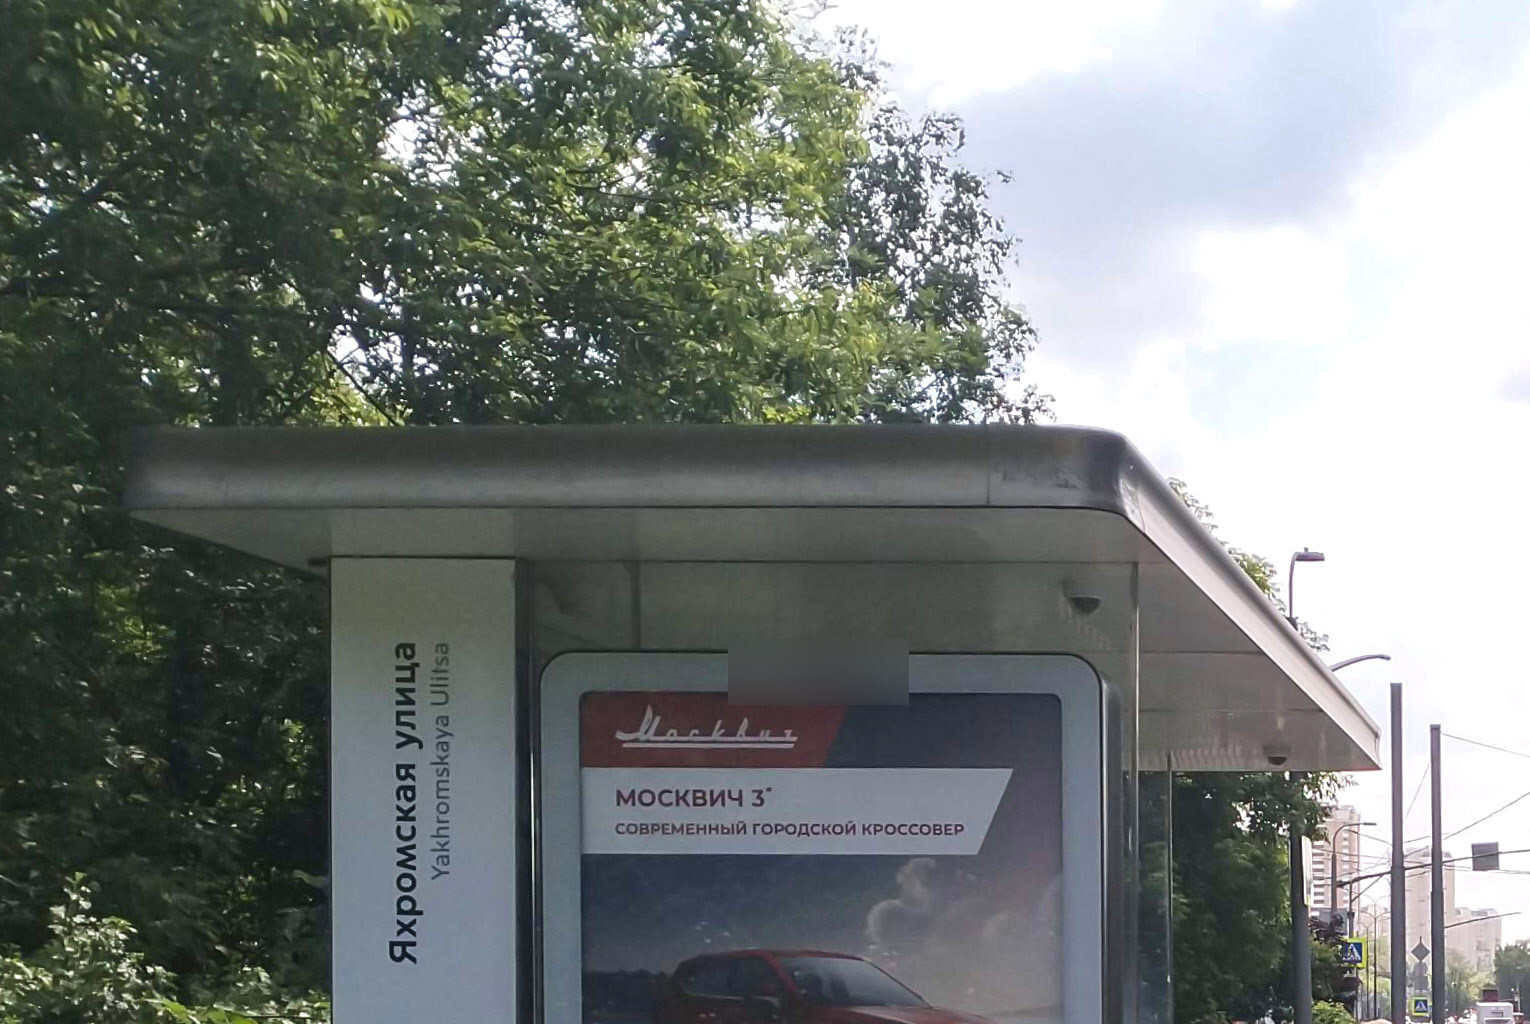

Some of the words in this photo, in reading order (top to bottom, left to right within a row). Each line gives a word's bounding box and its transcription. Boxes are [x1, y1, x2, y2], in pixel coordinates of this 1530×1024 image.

[394, 642, 424, 750] улица
[430, 642, 450, 707] Ulitsa
[430, 715, 454, 880] Yakhromskaya
[615, 789, 744, 808] МОСКВИЧ
[615, 821, 748, 836] СОВРЕМЕННЫЙ
[753, 821, 856, 838] ГОРОДСКОЙ
[862, 823, 965, 836] КРОССОВЕР
[389, 763, 424, 965] Яхромская
